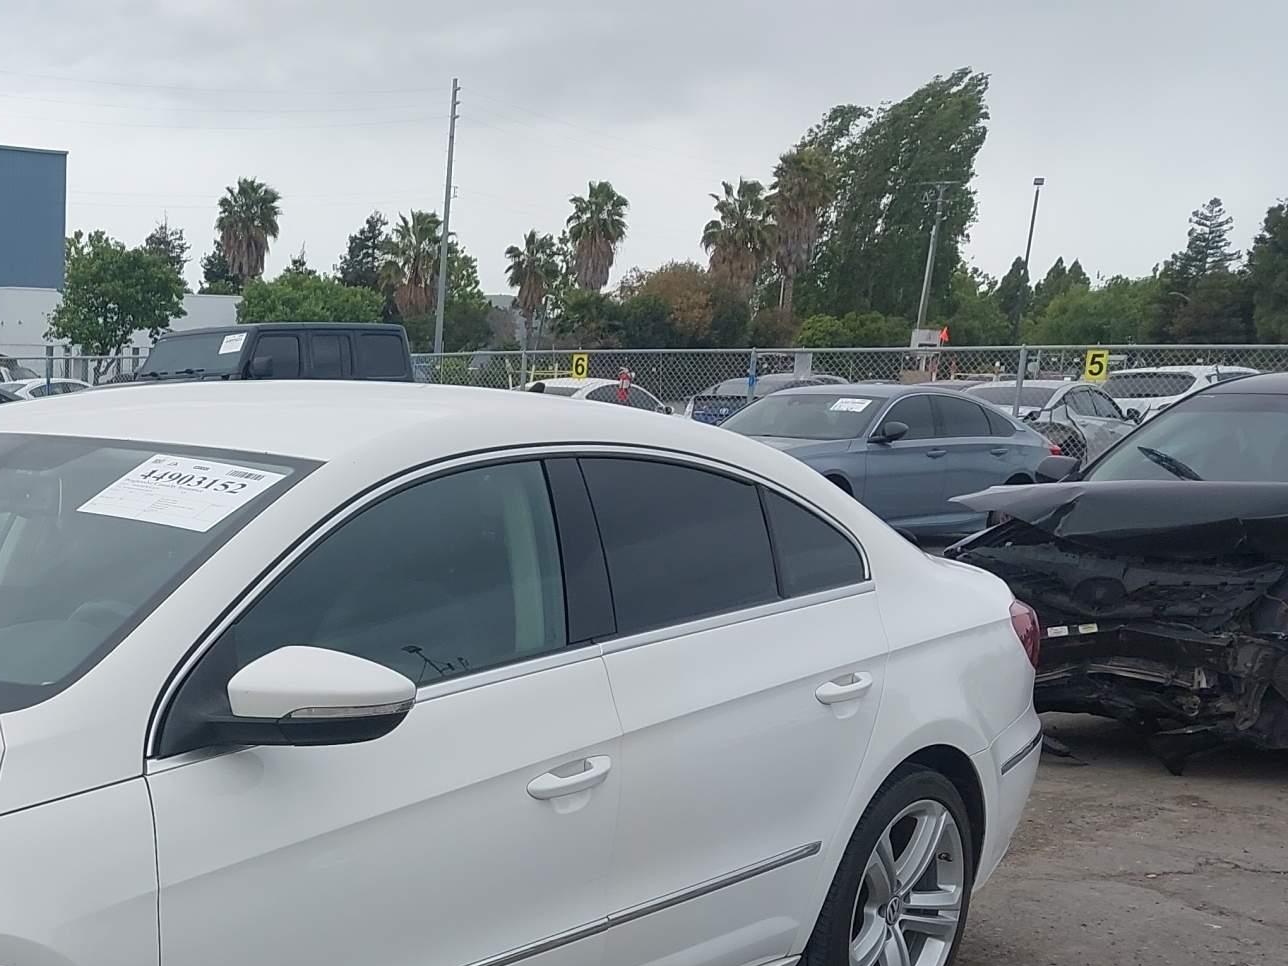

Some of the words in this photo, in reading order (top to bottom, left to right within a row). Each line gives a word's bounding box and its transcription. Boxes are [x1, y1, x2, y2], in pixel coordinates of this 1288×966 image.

[574, 356, 585, 376] 6
[1088, 353, 1105, 377] 5
[140, 469, 247, 493] 44903152
